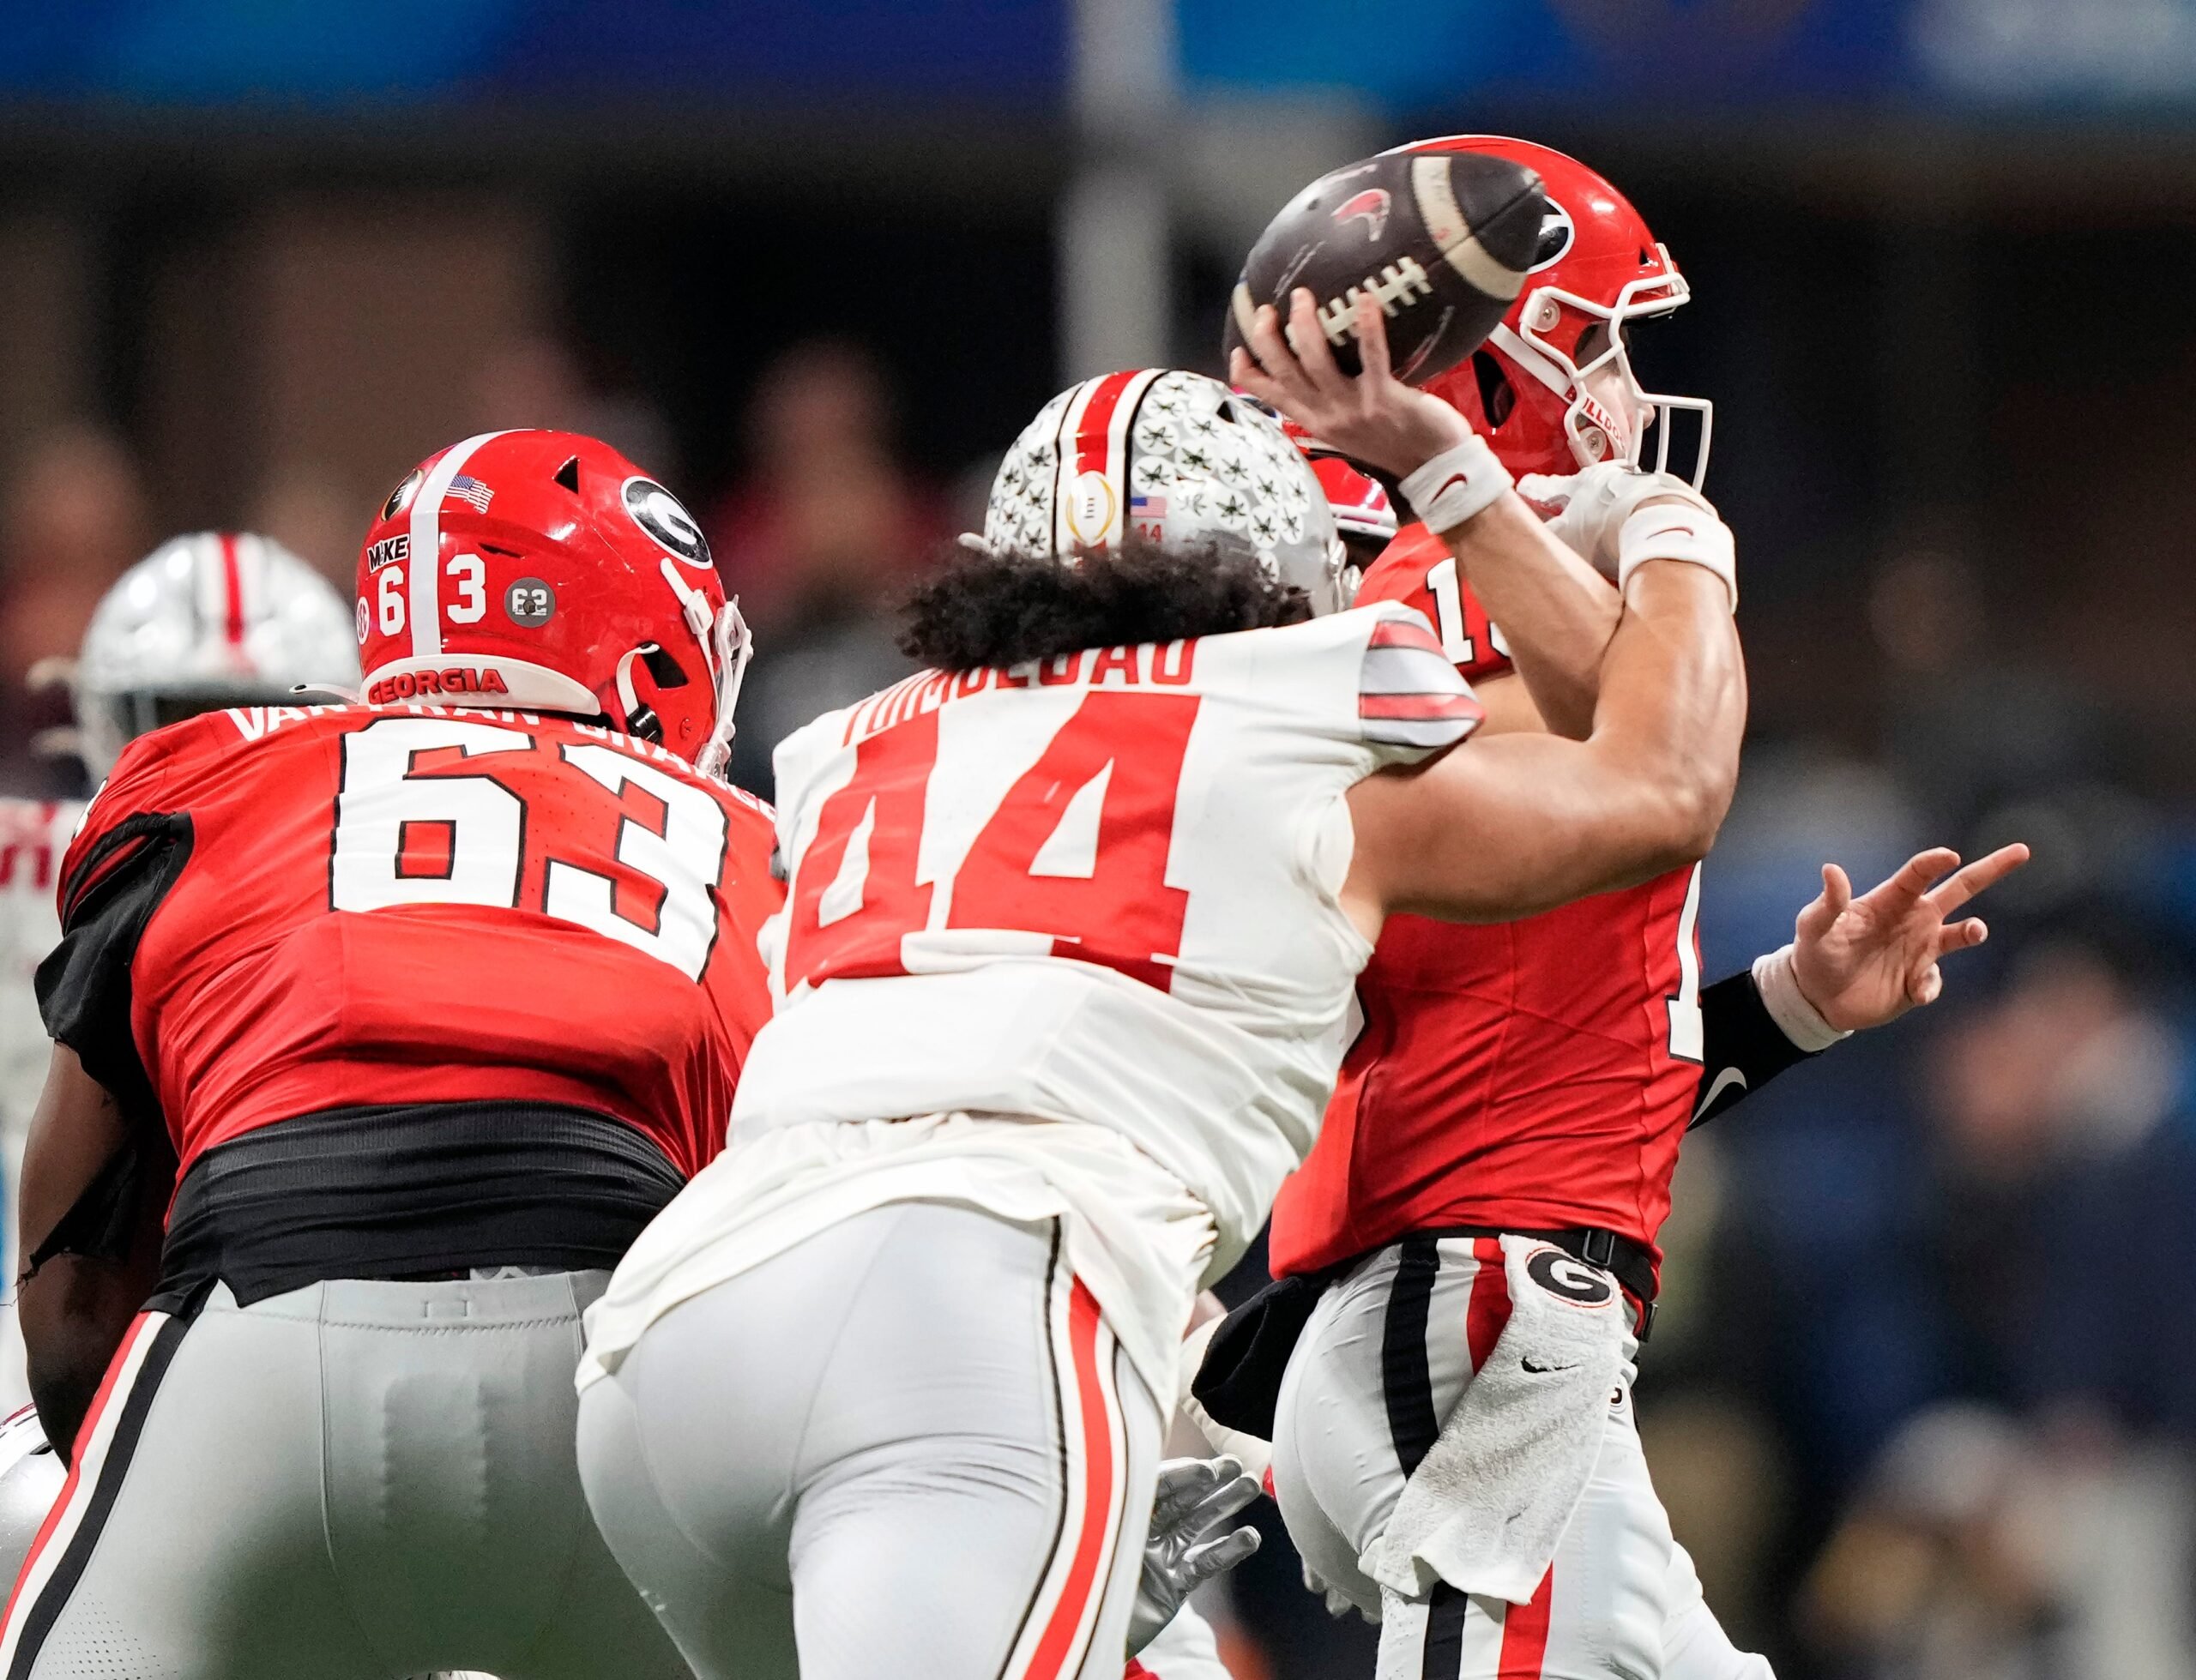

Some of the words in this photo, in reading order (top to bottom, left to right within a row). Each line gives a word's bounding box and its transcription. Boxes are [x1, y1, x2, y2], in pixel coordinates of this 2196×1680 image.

[367, 669, 509, 706] GEORGIA
[327, 715, 729, 985] 63
[783, 690, 1202, 998] 44
